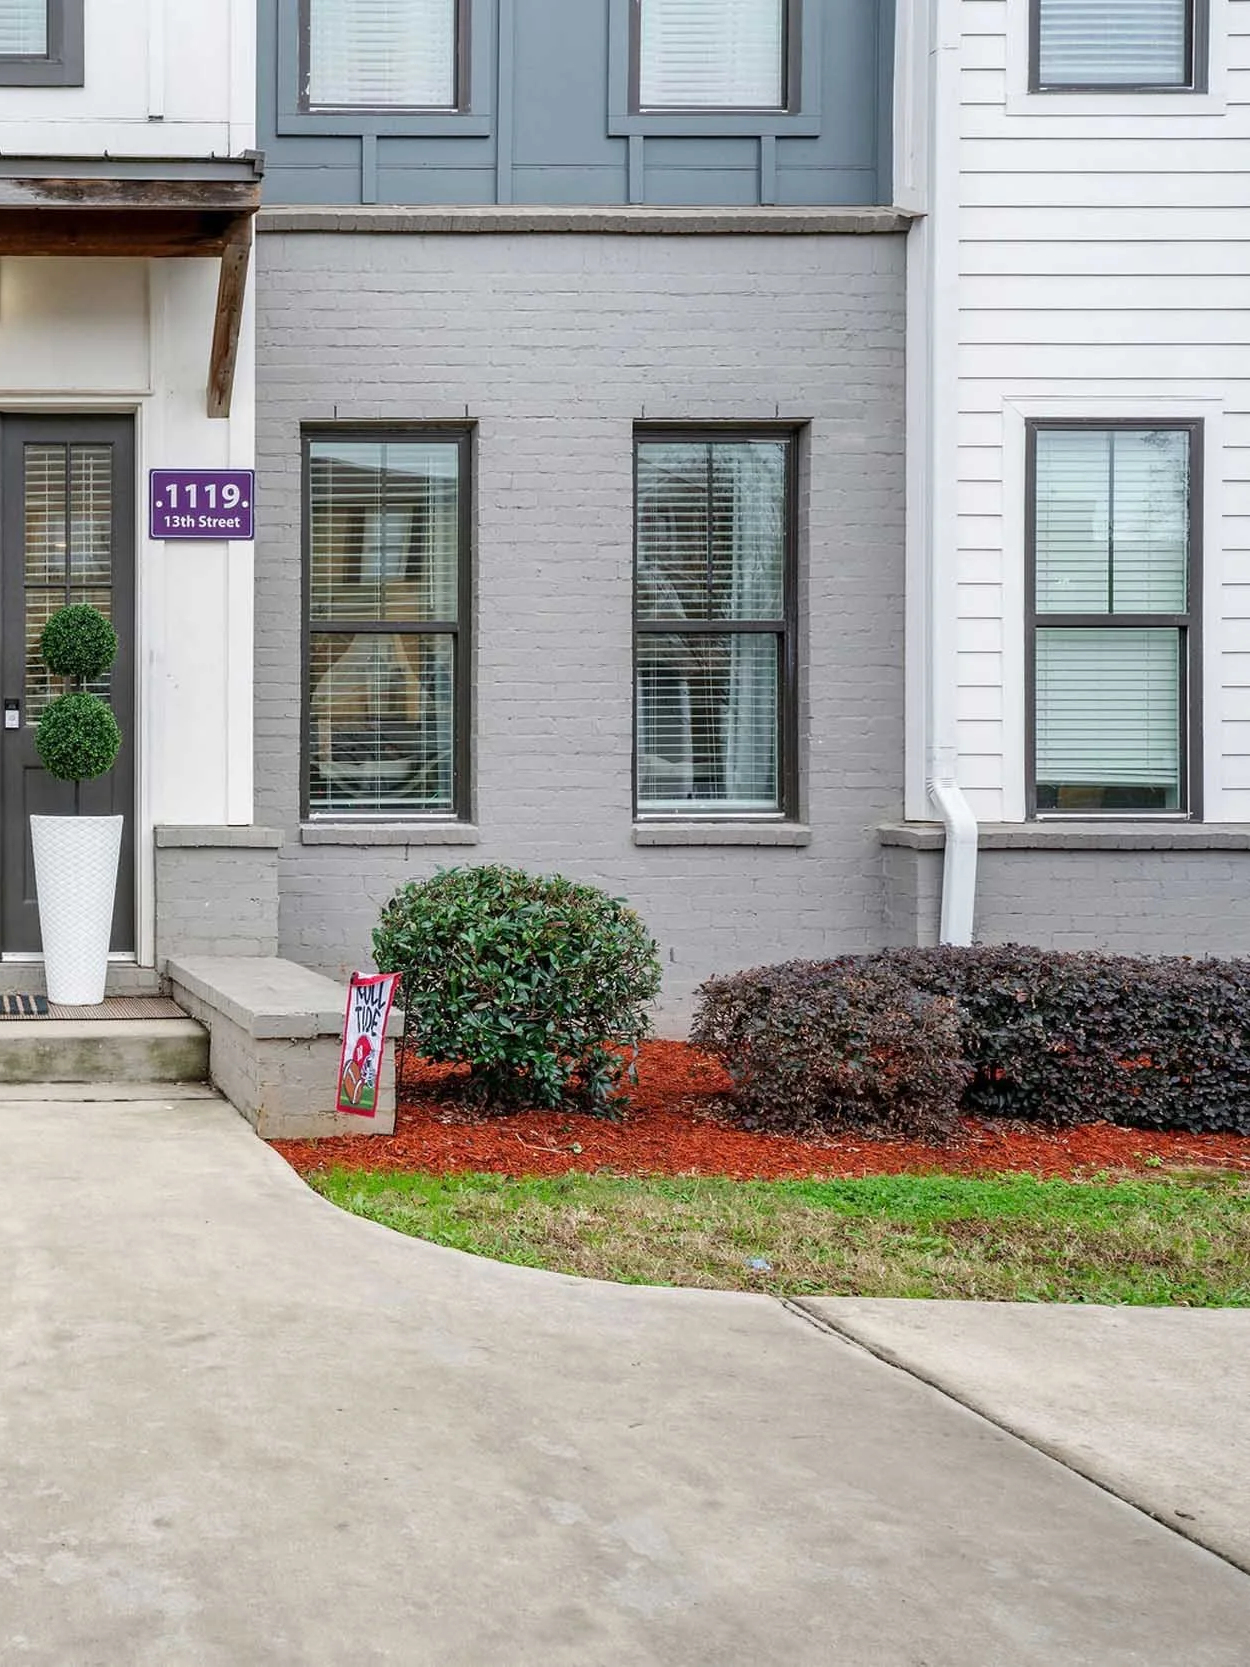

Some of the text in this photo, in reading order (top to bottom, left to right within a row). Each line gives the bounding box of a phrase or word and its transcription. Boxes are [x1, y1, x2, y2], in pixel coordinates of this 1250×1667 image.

[165, 483, 241, 509] 1119
[163, 514, 241, 528] 13th Street
[354, 1005, 381, 1037] TIDE
